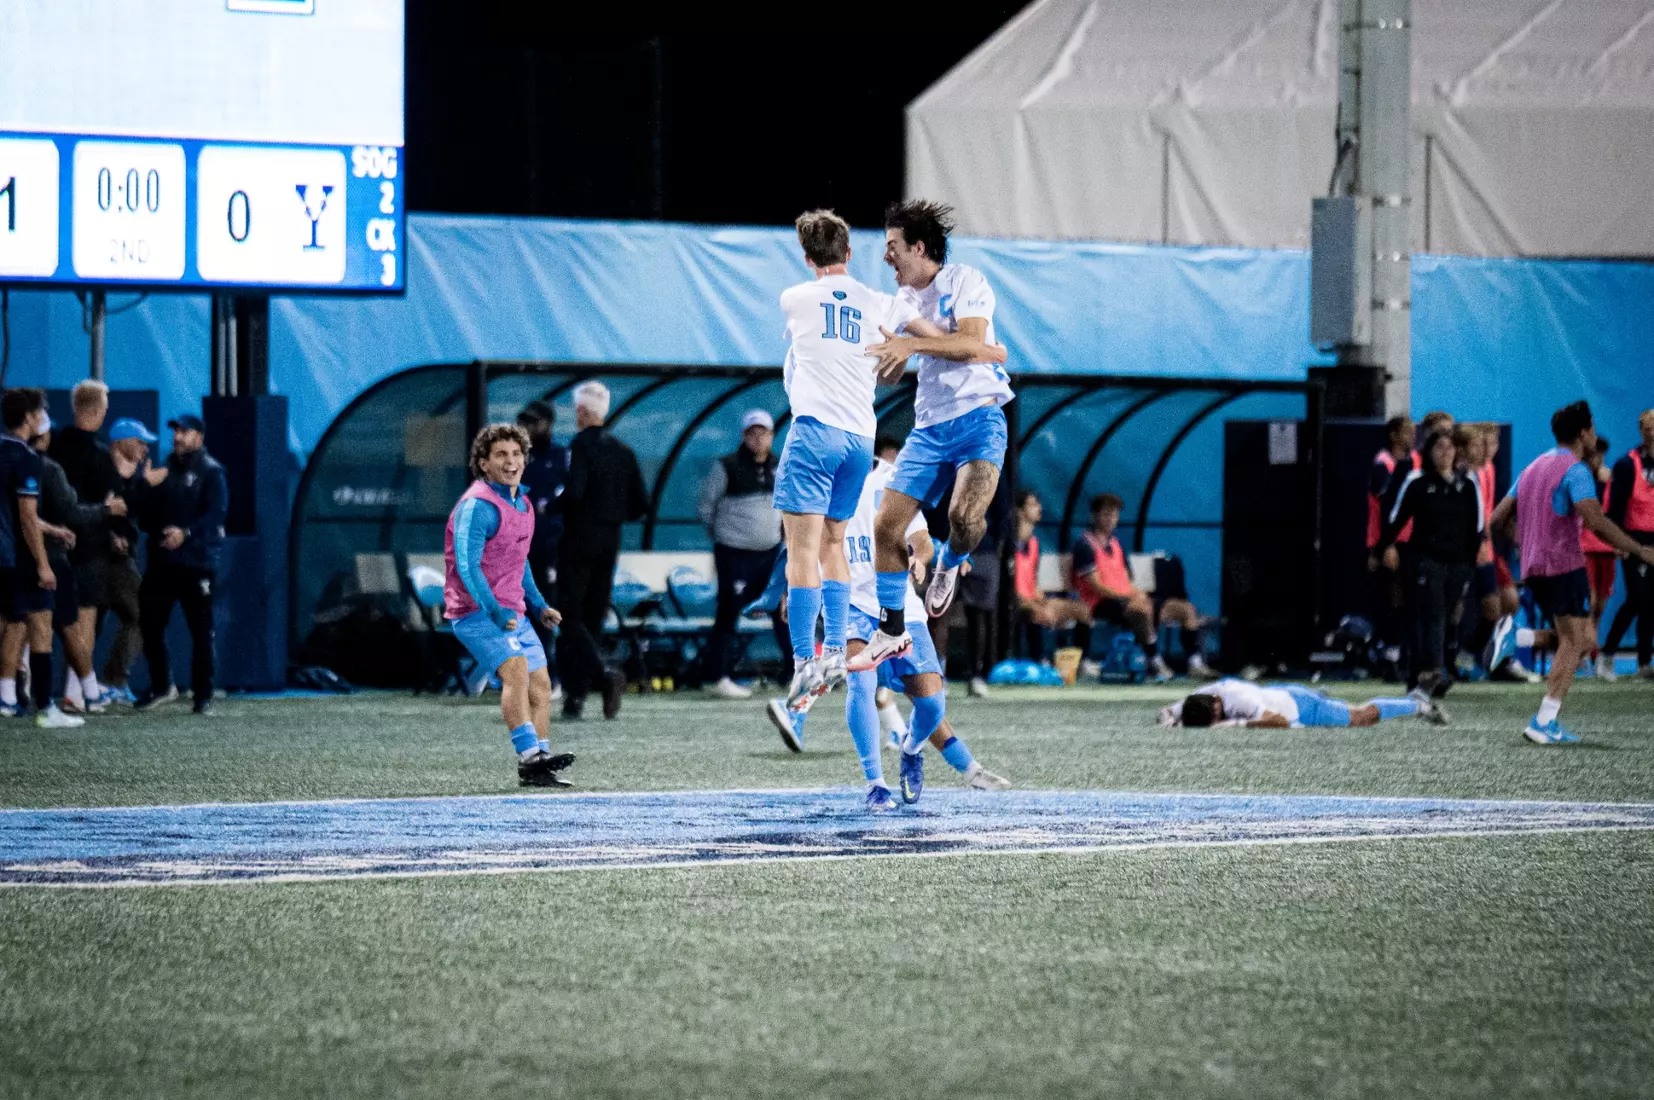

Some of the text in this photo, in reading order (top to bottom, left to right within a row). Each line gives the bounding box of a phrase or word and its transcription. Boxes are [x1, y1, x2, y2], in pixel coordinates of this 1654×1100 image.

[353, 146, 397, 178] SOG
[0, 176, 16, 232] 1
[97, 167, 160, 213] 0:00
[381, 182, 395, 213] 2
[227, 190, 251, 243] 0
[295, 185, 334, 252] Y
[109, 238, 151, 264] 2ND
[820, 302, 862, 344] 16
[846, 535, 872, 564] 19
